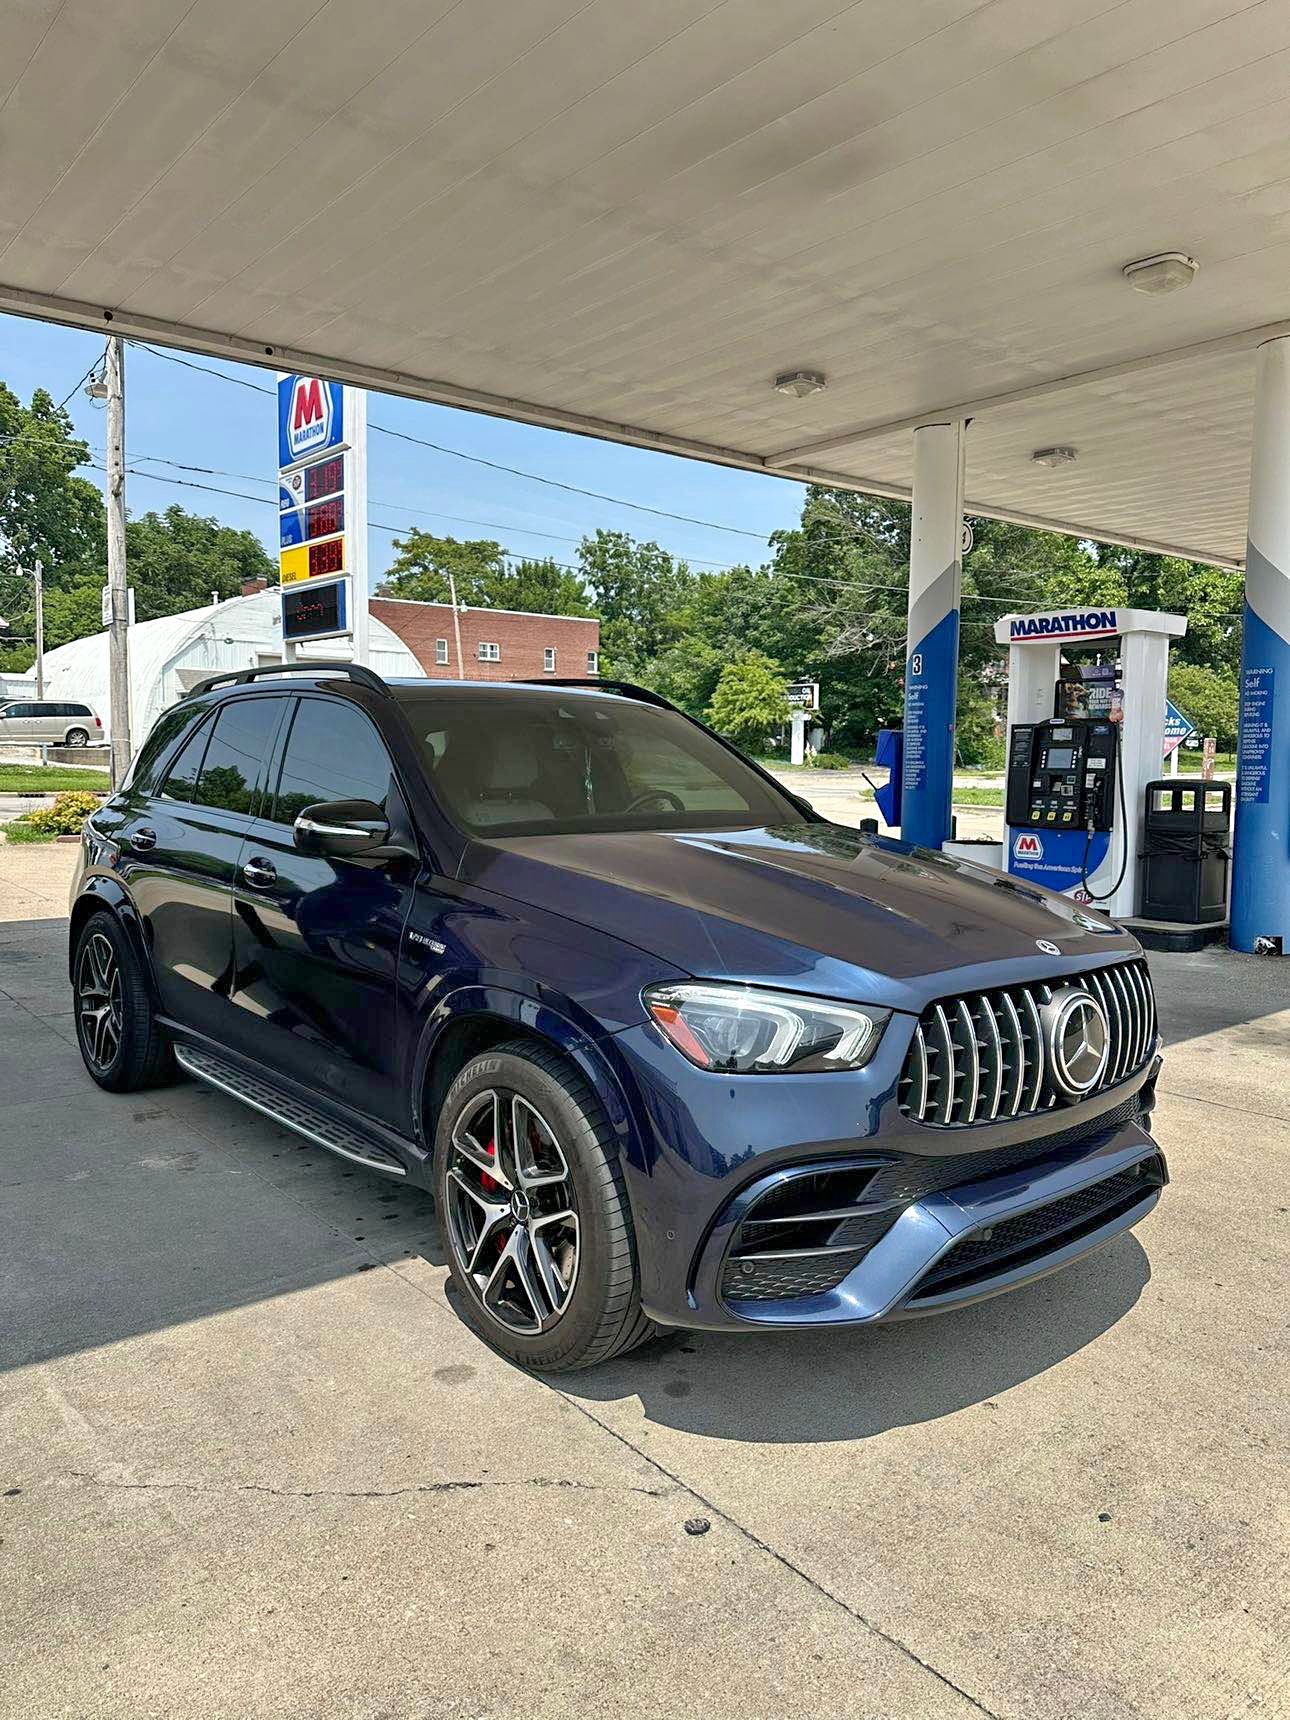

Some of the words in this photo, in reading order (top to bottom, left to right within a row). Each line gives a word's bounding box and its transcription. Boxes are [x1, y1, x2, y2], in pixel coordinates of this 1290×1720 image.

[295, 377, 323, 430] M
[294, 422, 325, 445] MARATHON
[1010, 611, 1117, 637] MARATHON
[913, 655, 921, 674] 3
[1245, 677, 1260, 688] Self
[1089, 687, 1112, 699] RIDE
[1020, 838, 1037, 850] M
[1014, 862, 1033, 870] Fueling
[1044, 864, 1071, 872] American
